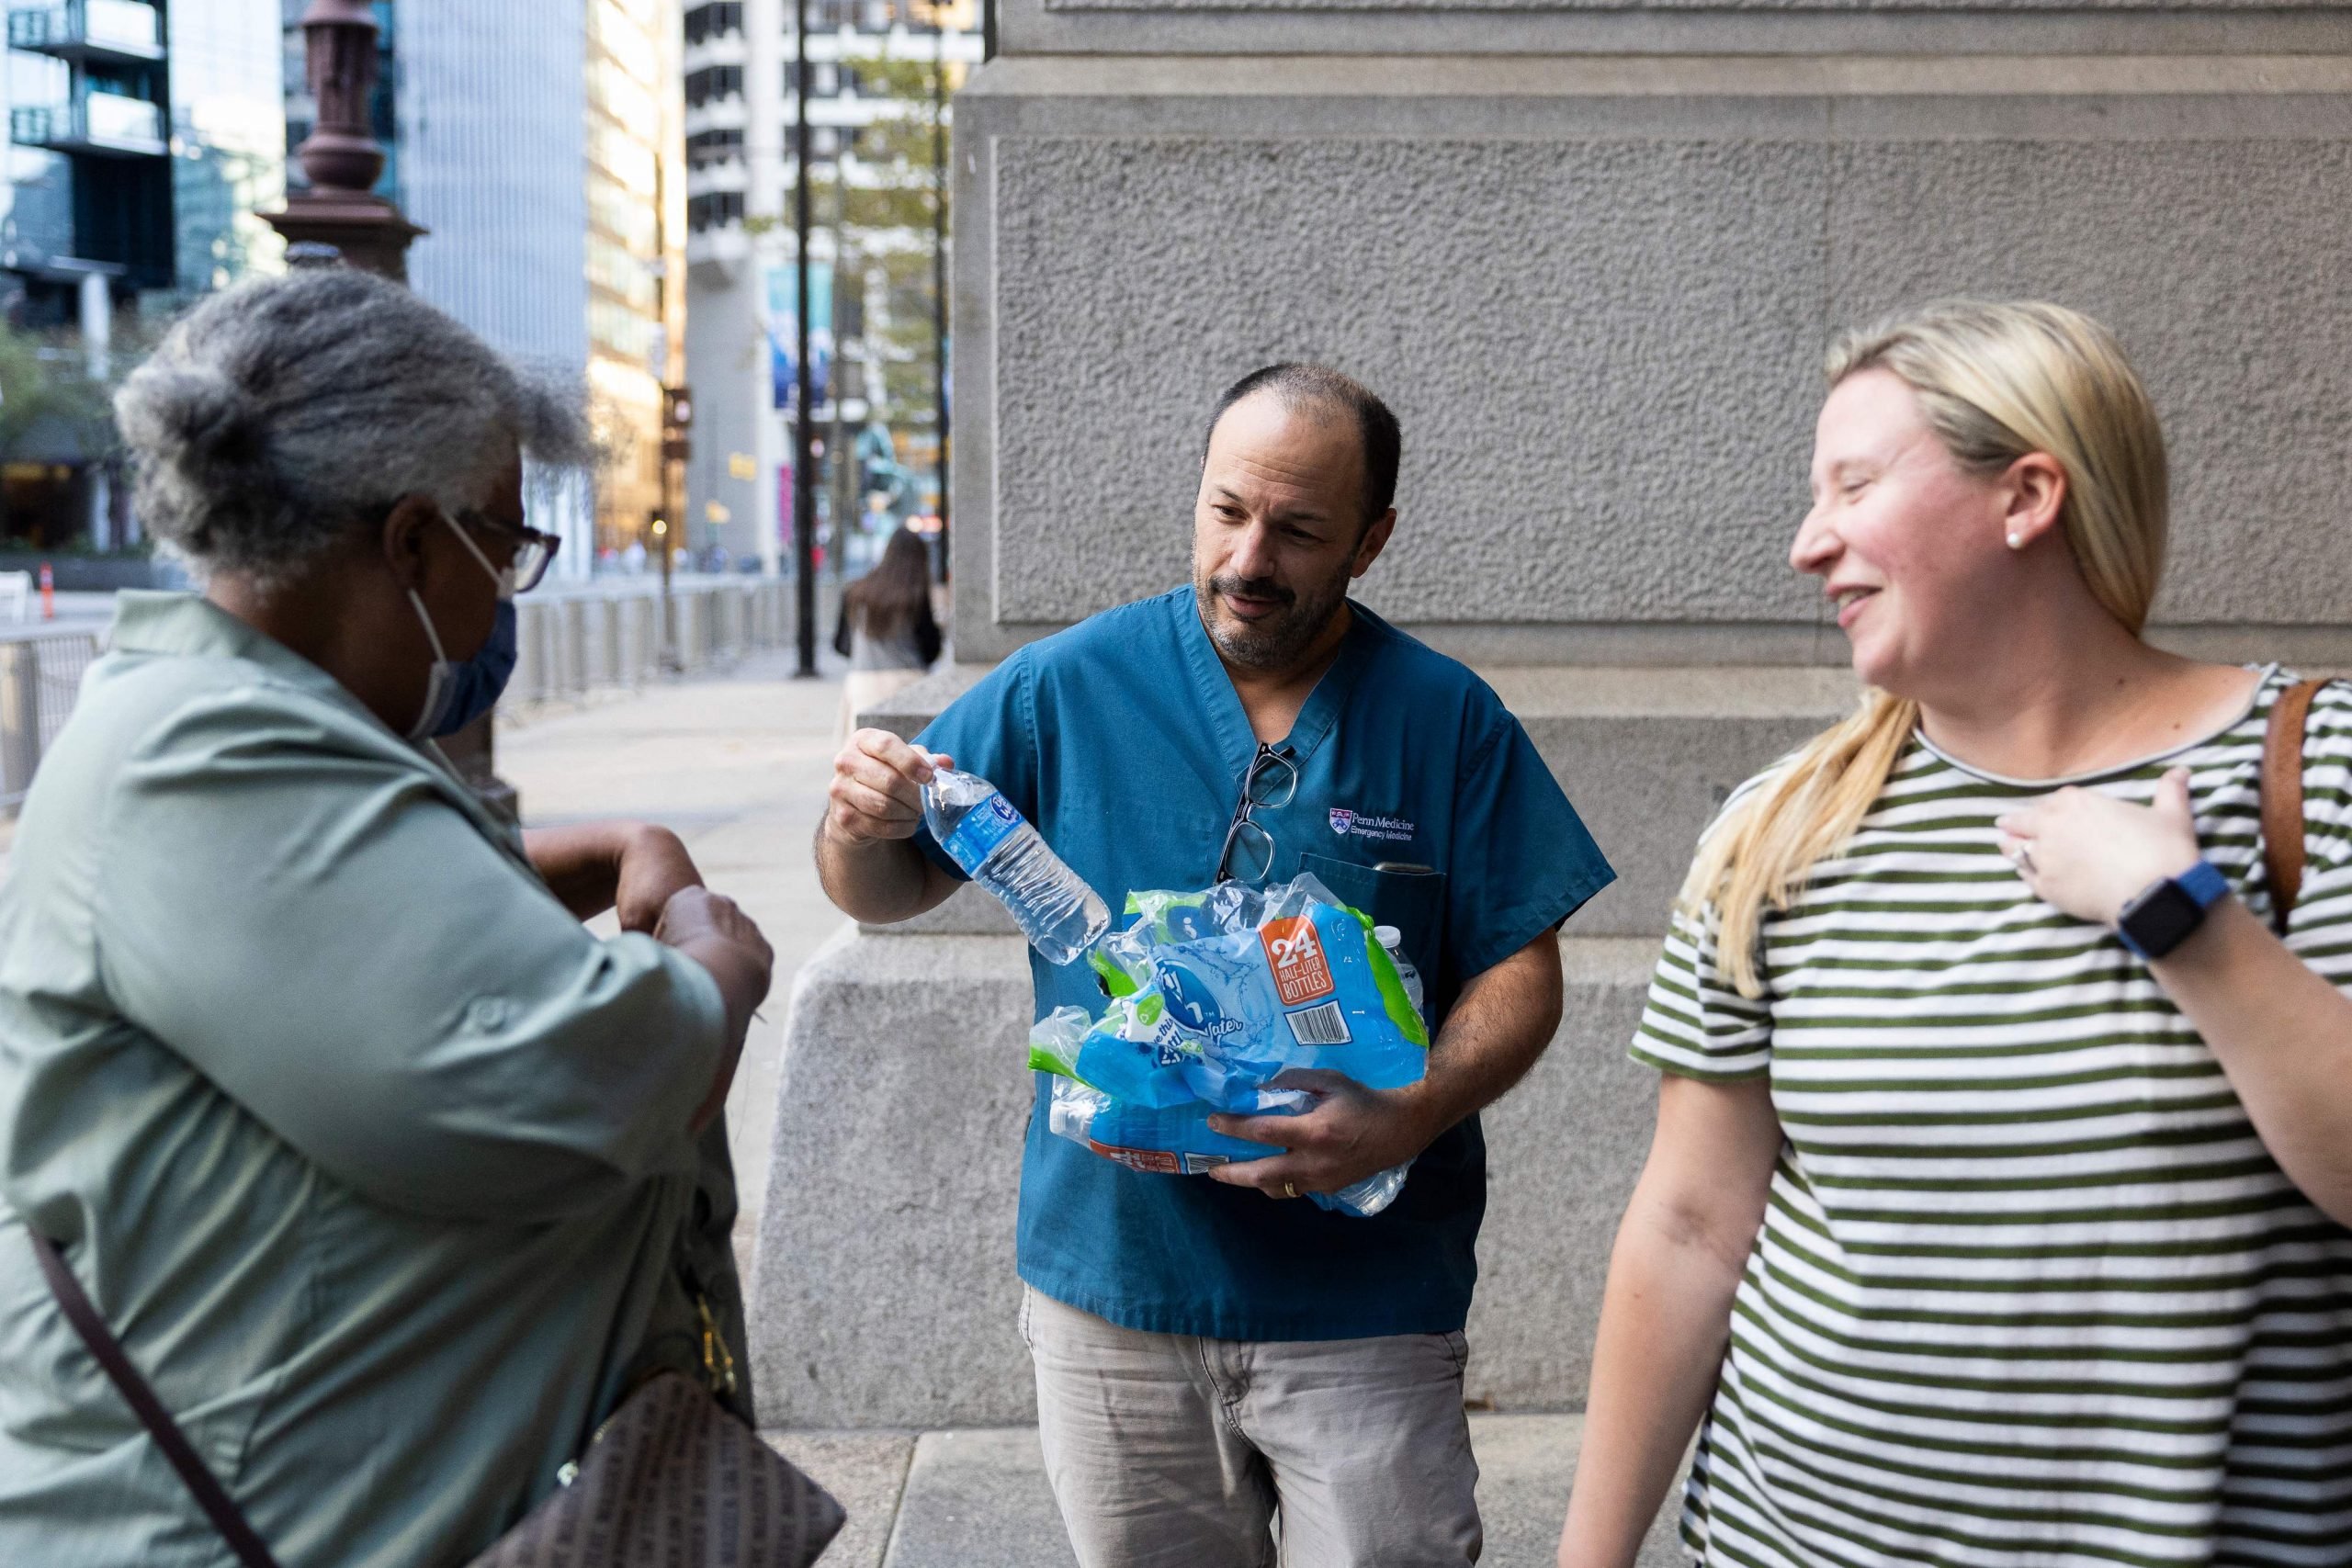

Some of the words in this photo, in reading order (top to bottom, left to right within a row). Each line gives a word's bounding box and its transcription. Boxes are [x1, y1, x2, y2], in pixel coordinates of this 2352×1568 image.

[1352, 812, 1374, 826] Penn
[1375, 817, 1415, 830] Medicine
[1351, 825, 1385, 840] Emergency
[1385, 830, 1412, 841] Medicine
[1271, 929, 1317, 969] 24
[1279, 956, 1322, 983] HALF-LITER
[1283, 970, 1327, 999] BOTTLES
[1159, 1017, 1174, 1037] this
